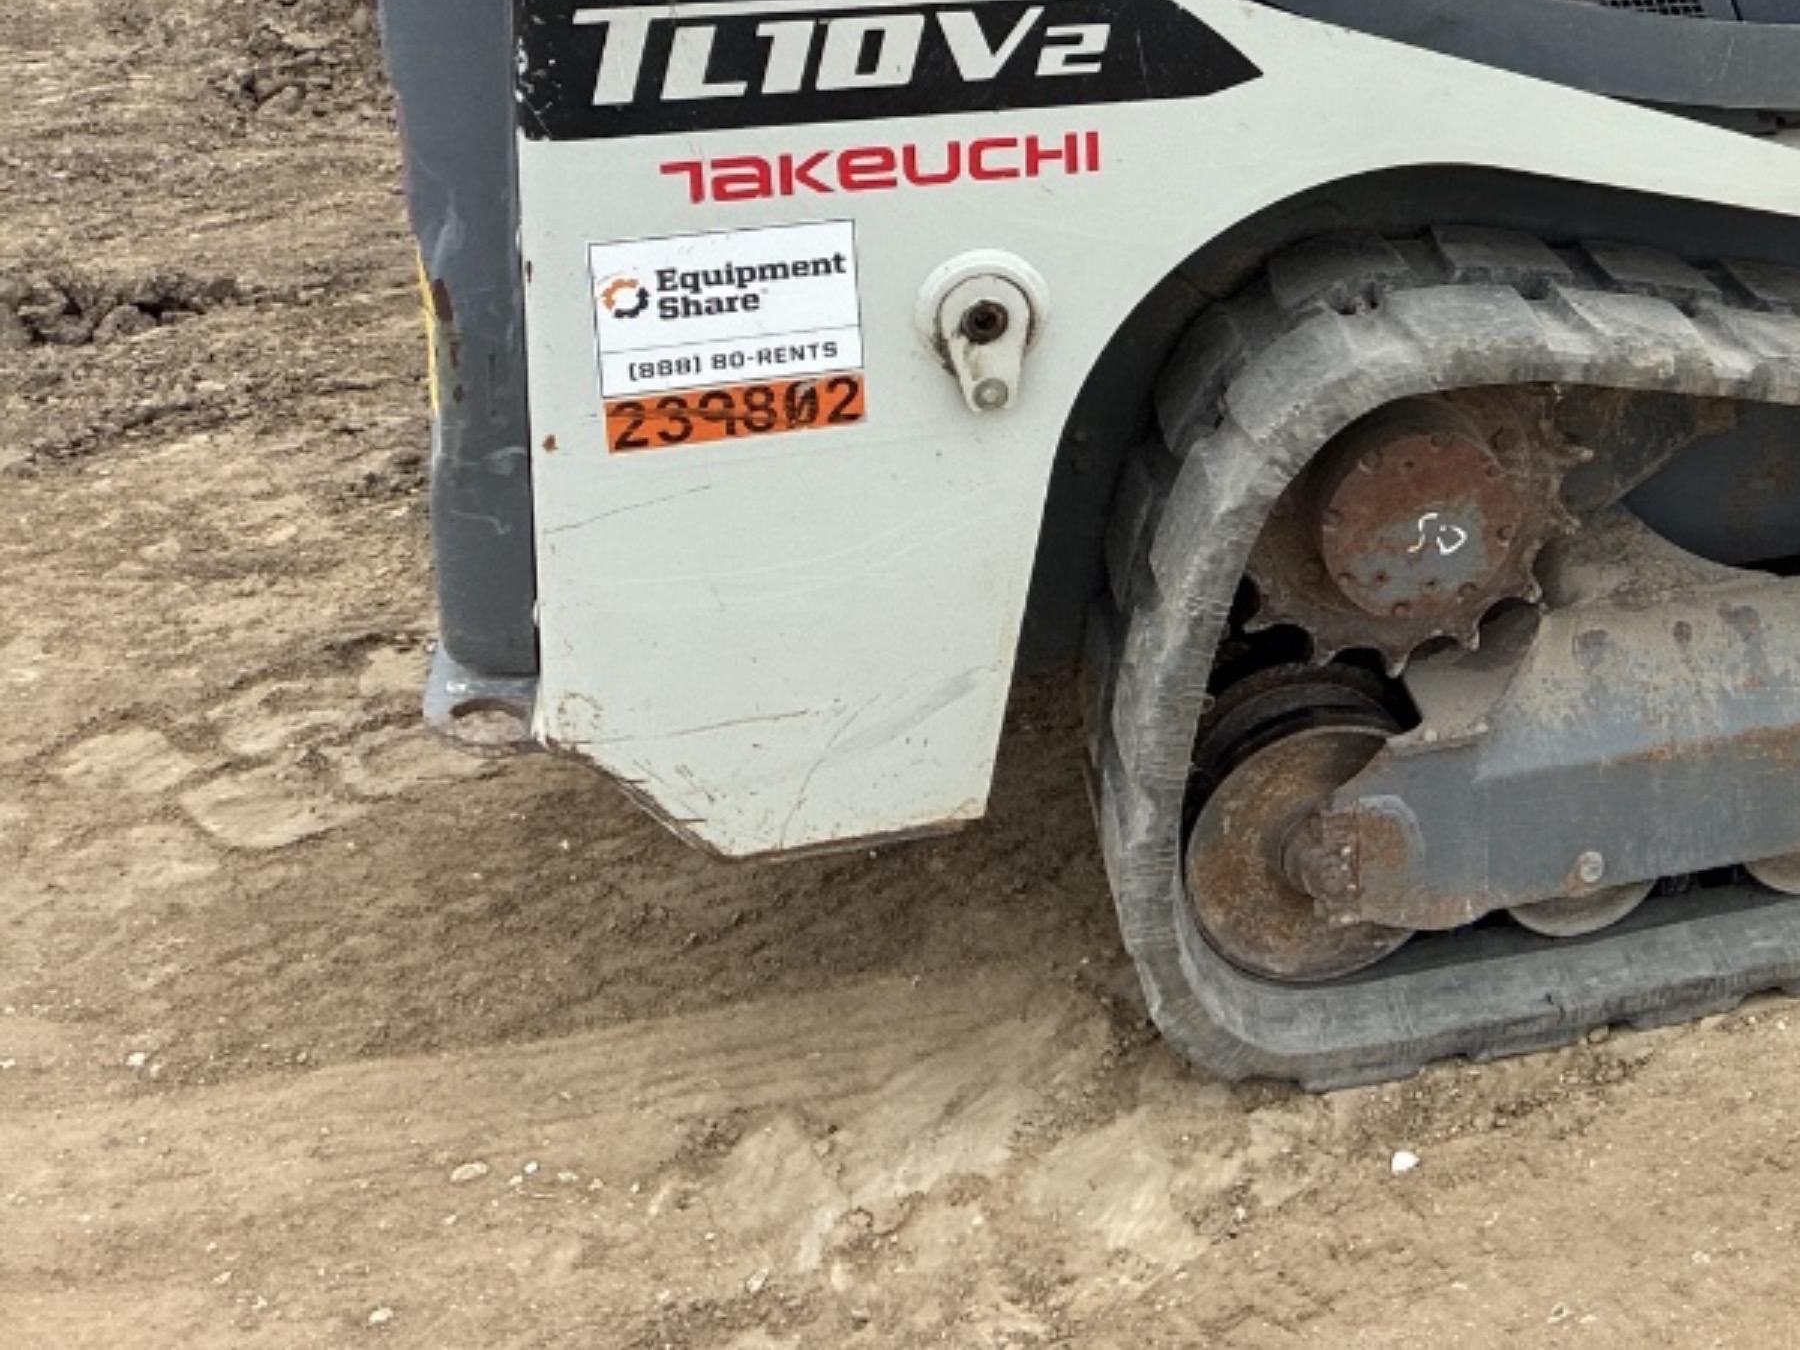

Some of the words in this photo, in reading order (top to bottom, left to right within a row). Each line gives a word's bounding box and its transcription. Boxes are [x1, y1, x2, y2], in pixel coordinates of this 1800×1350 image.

[659, 131, 1100, 204] TAKEUCHI
[654, 251, 847, 294] Equipment
[656, 291, 761, 321] Share
[710, 340, 839, 371] 80-RENTS
[612, 373, 860, 451] 239802
